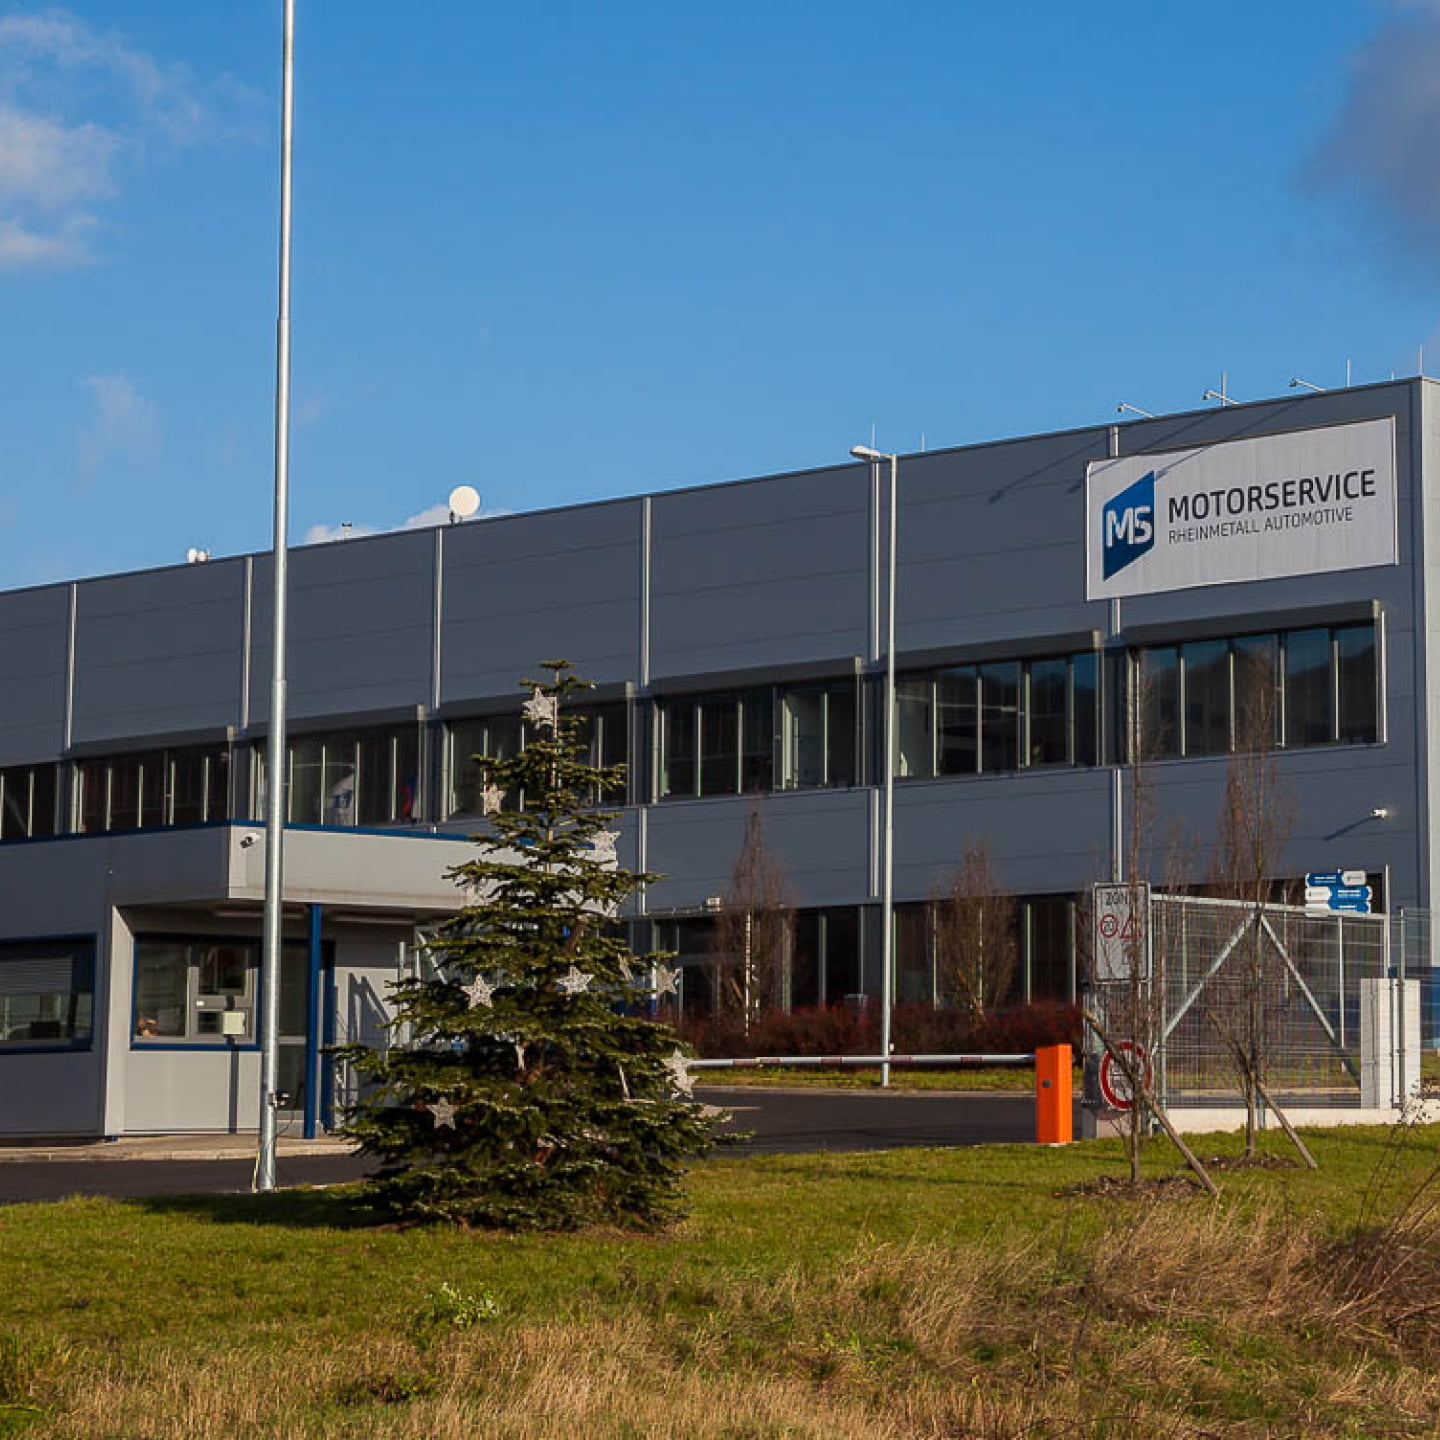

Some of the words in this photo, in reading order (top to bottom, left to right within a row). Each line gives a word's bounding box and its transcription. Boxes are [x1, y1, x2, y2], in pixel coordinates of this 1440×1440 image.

[1168, 469, 1376, 523] MOTORSERVICE
[1105, 505, 1152, 548] MS
[1168, 520, 1260, 545] RHEINMETALL
[1264, 507, 1353, 531] AUTOMOTIVE
